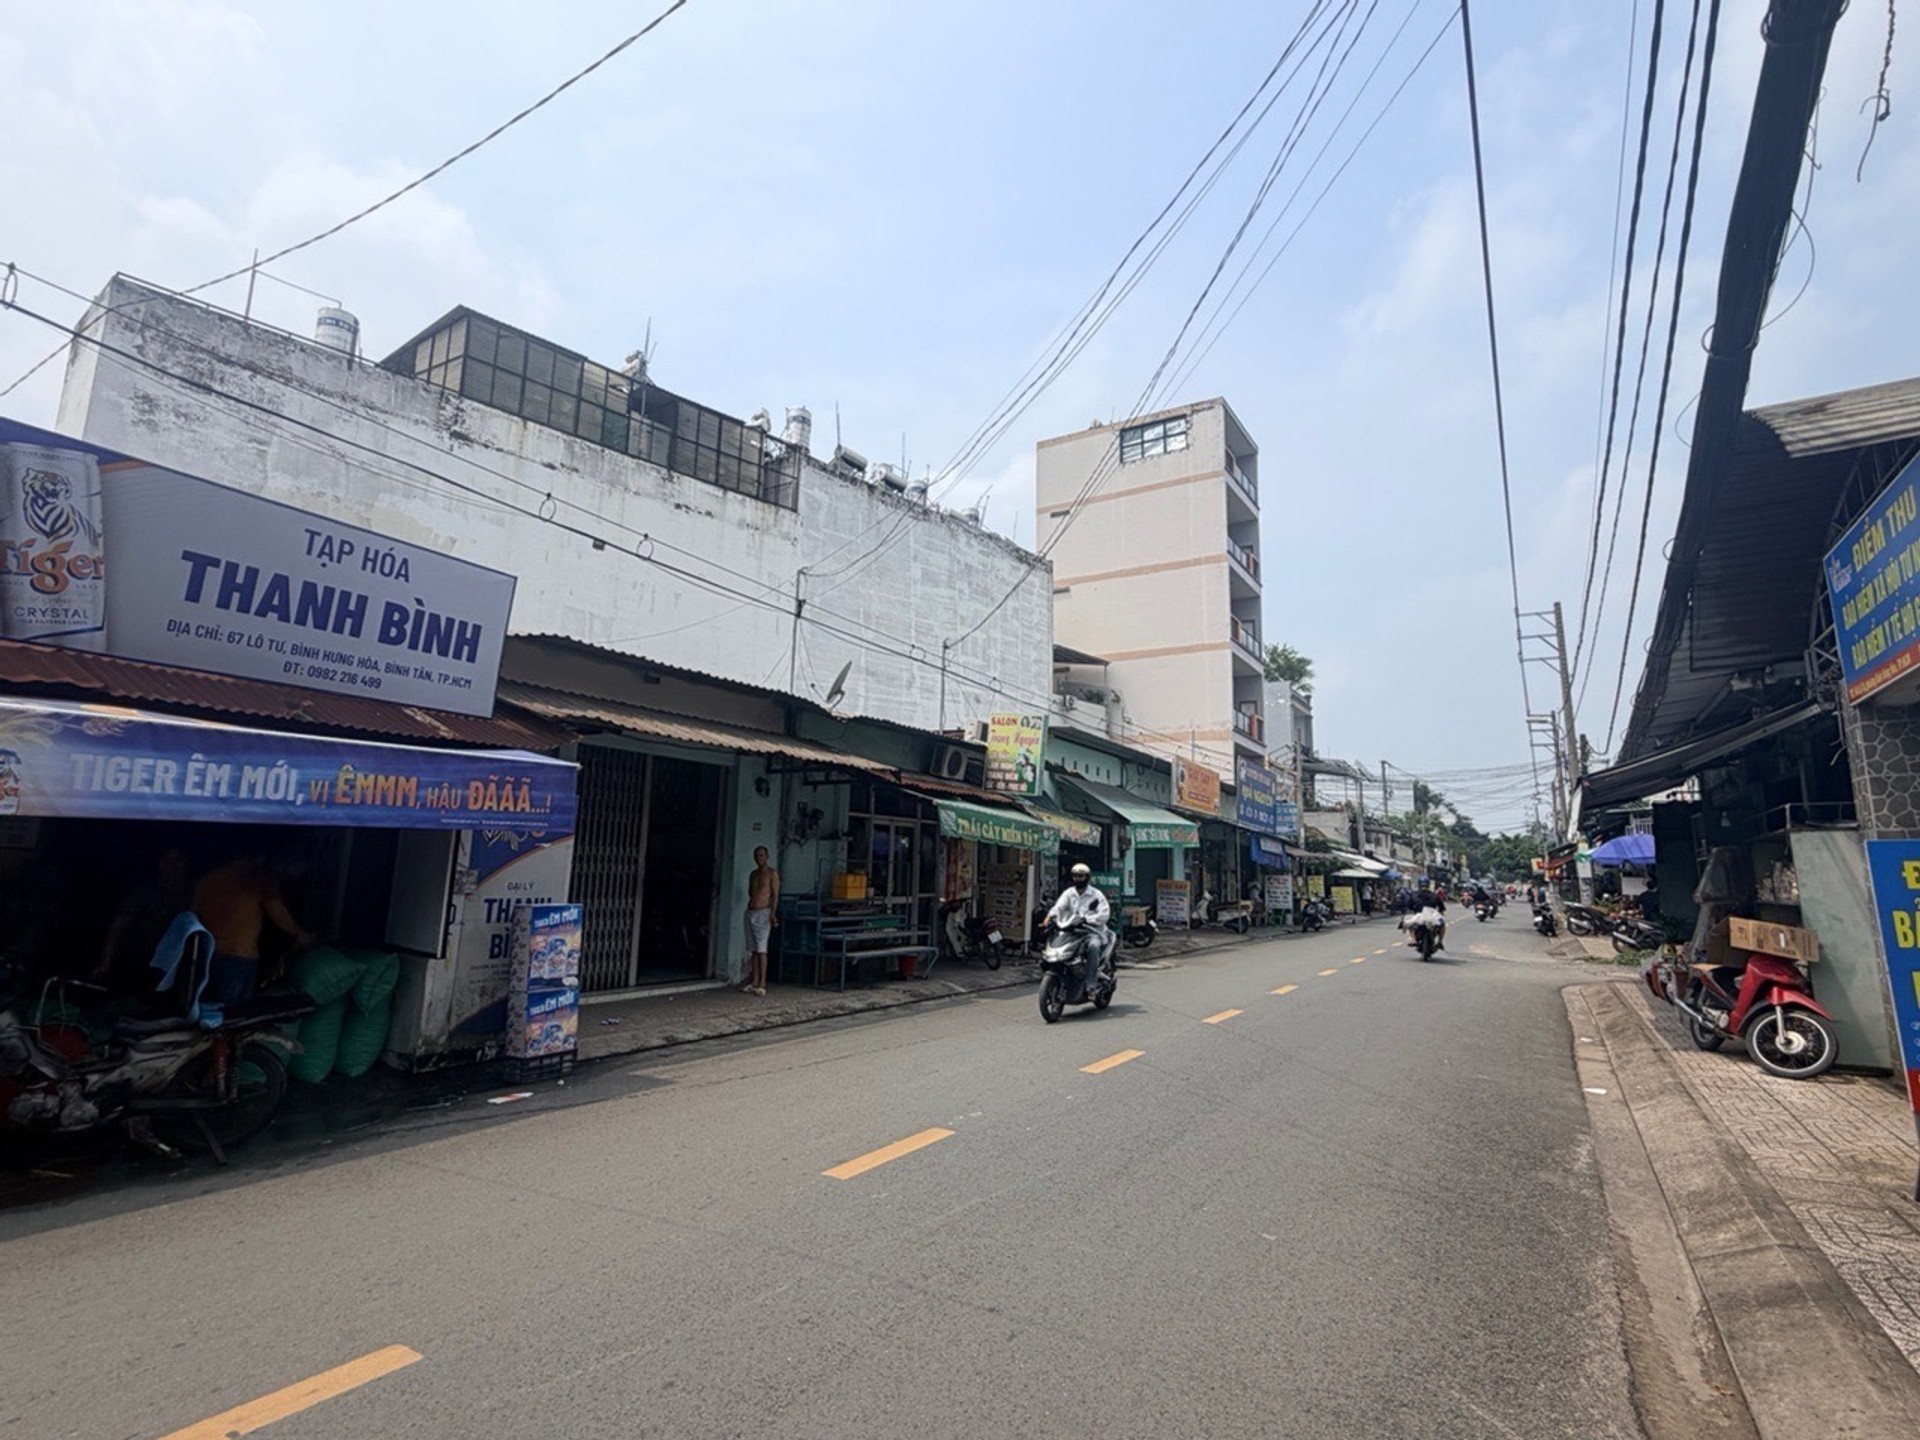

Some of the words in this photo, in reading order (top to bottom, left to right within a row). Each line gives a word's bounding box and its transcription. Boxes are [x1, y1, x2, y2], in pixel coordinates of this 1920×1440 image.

[305, 528, 355, 568] TẠP
[361, 547, 410, 583] HÓA
[1852, 516, 1886, 573] ĐIỂM
[1886, 484, 1917, 538] THU
[14, 605, 89, 620] CRYSTAL
[181, 550, 369, 638] THANH
[378, 597, 482, 664] BÌNH
[167, 619, 191, 637] ĐỊA
[195, 624, 224, 642] CHỈ:
[227, 630, 245, 646] 67
[247, 634, 263, 649] LÔ
[268, 639, 287, 655] TƯ,
[290, 641, 319, 660] BÌNH
[322, 648, 354, 666] HƯNG
[357, 655, 381, 672] HÒA,
[384, 661, 410, 677] BÌNH
[413, 667, 434, 683] TÂN,
[437, 672, 472, 689] TP.HCM
[283, 659, 304, 678] ĐT:
[307, 665, 336, 682] 0982
[339, 671, 358, 686] 216
[361, 675, 382, 689] 499
[69, 753, 178, 795] TIGER
[184, 753, 231, 798] ÊM
[238, 759, 304, 805] MỚI,
[310, 779, 328, 809] VỊ
[334, 764, 420, 809] ÊMMM,
[426, 782, 461, 815] HẬU
[489, 927, 511, 959] BÌ
